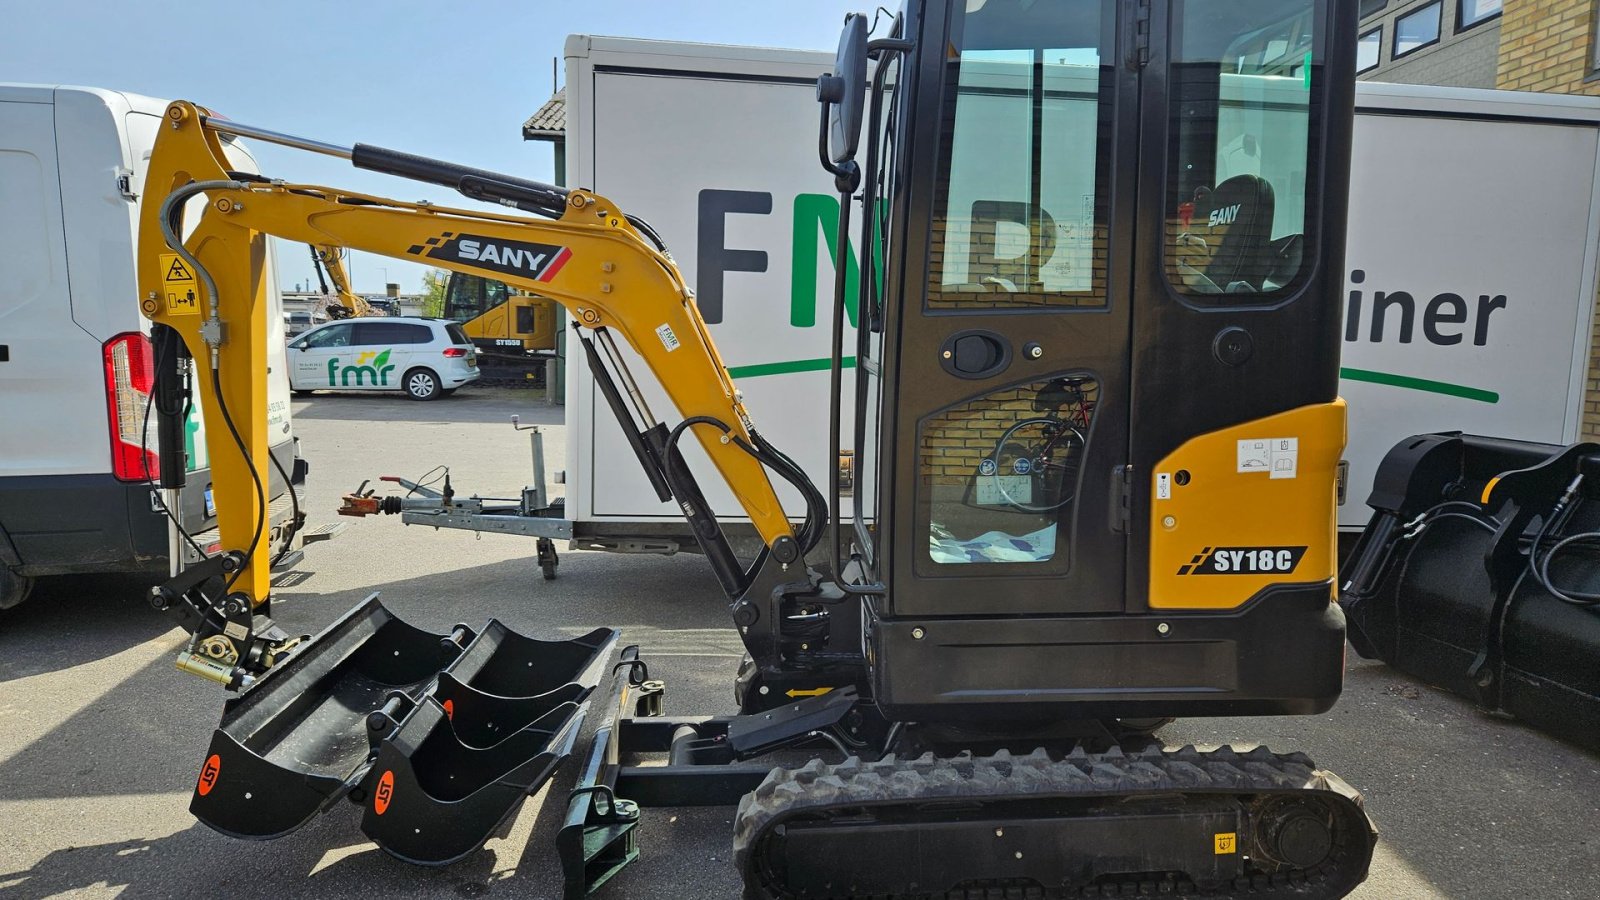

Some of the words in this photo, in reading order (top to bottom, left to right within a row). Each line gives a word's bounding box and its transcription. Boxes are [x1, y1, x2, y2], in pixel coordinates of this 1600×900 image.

[1207, 203, 1242, 227] SANY
[457, 238, 547, 272] SANY
[1345, 269, 1507, 346] iner
[663, 327, 678, 346] FMR
[327, 357, 396, 387] fmr
[1213, 549, 1293, 572] SY18C
